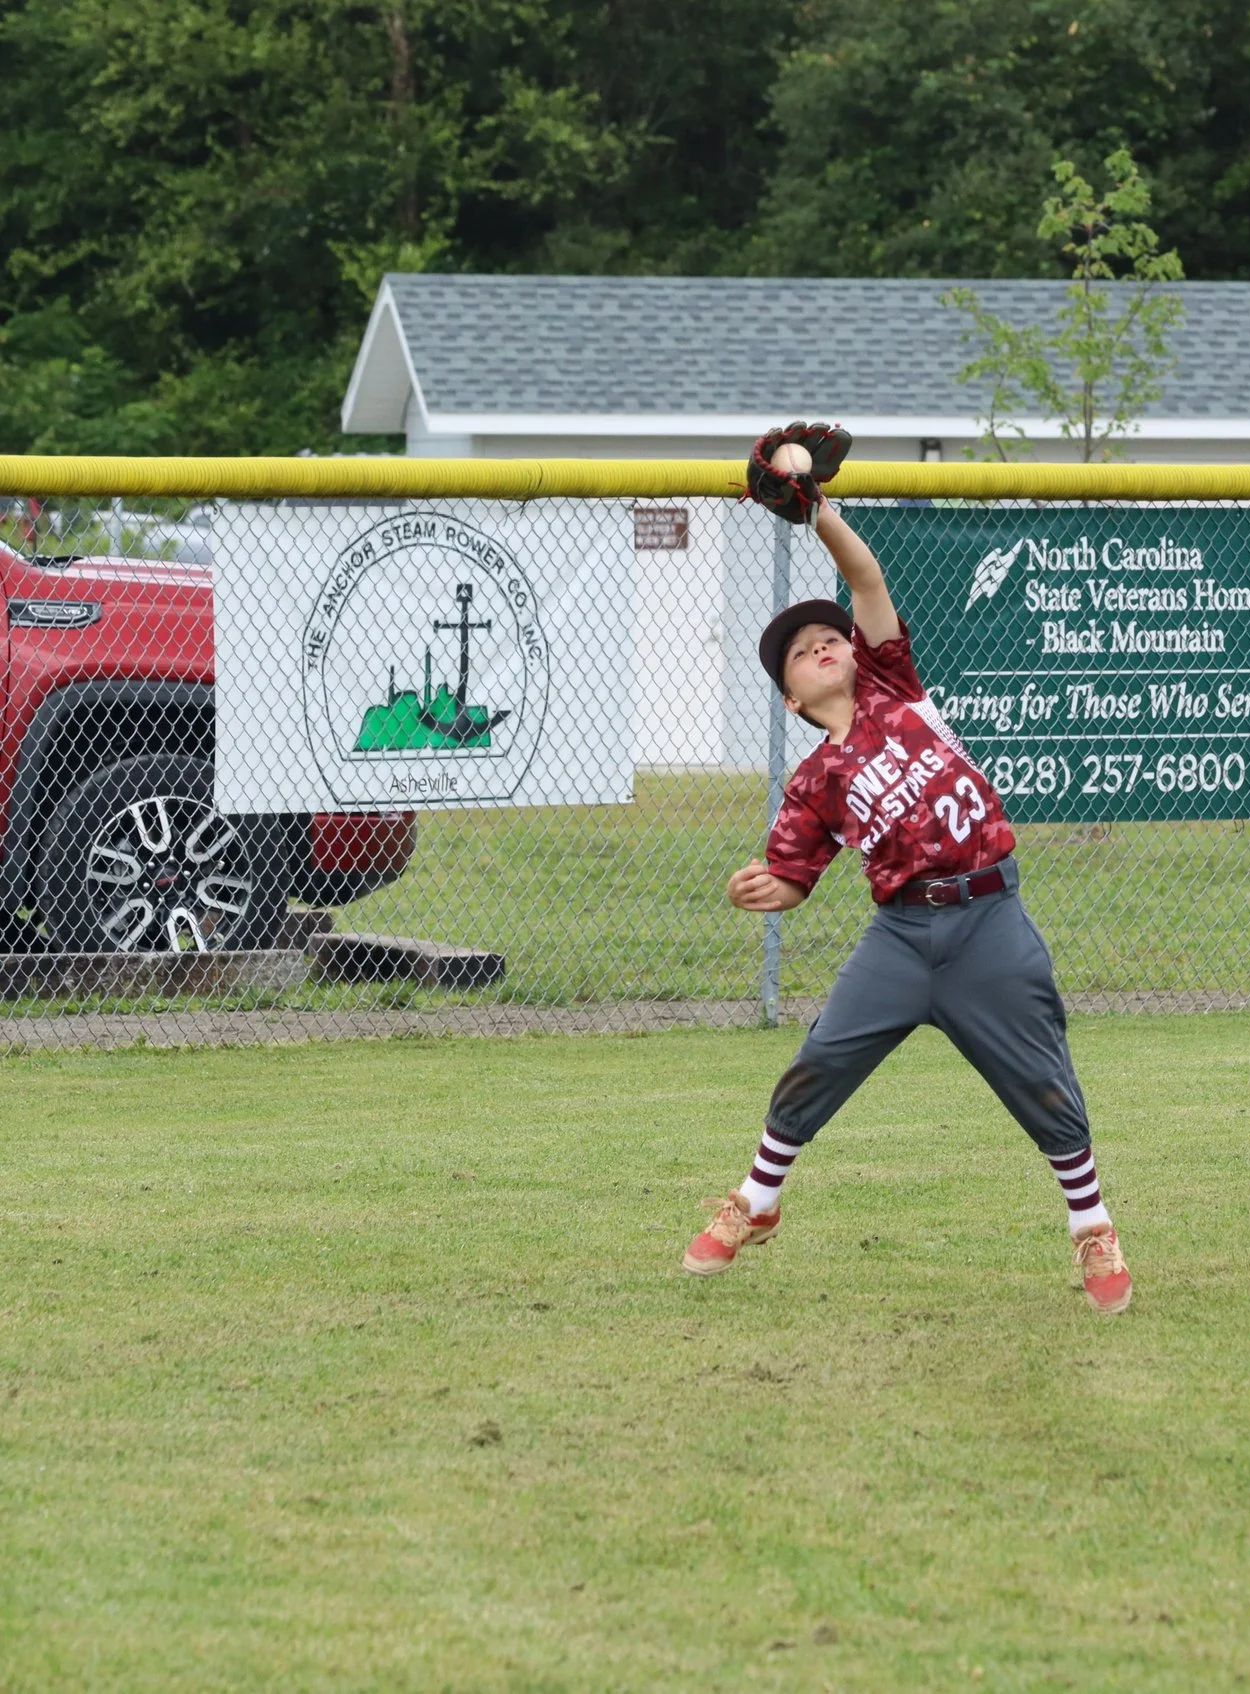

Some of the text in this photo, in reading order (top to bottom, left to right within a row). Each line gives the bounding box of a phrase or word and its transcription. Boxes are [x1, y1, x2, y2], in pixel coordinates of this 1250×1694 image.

[1025, 536, 1204, 571] North Carolina
[307, 521, 543, 672] THE ANCHOR STEAM POWER CO. INC.
[1024, 579, 1082, 612] State
[1087, 579, 1188, 612] Veterans
[1041, 618, 1107, 653] Black
[1109, 621, 1226, 653] Mountain
[1013, 682, 1060, 732] for
[1066, 682, 1143, 720] Those
[1148, 682, 1209, 719] Who
[389, 772, 458, 793] Asheville
[845, 735, 910, 824] OWEN
[1082, 753, 1246, 794] 257-6800
[933, 775, 987, 845] 23
